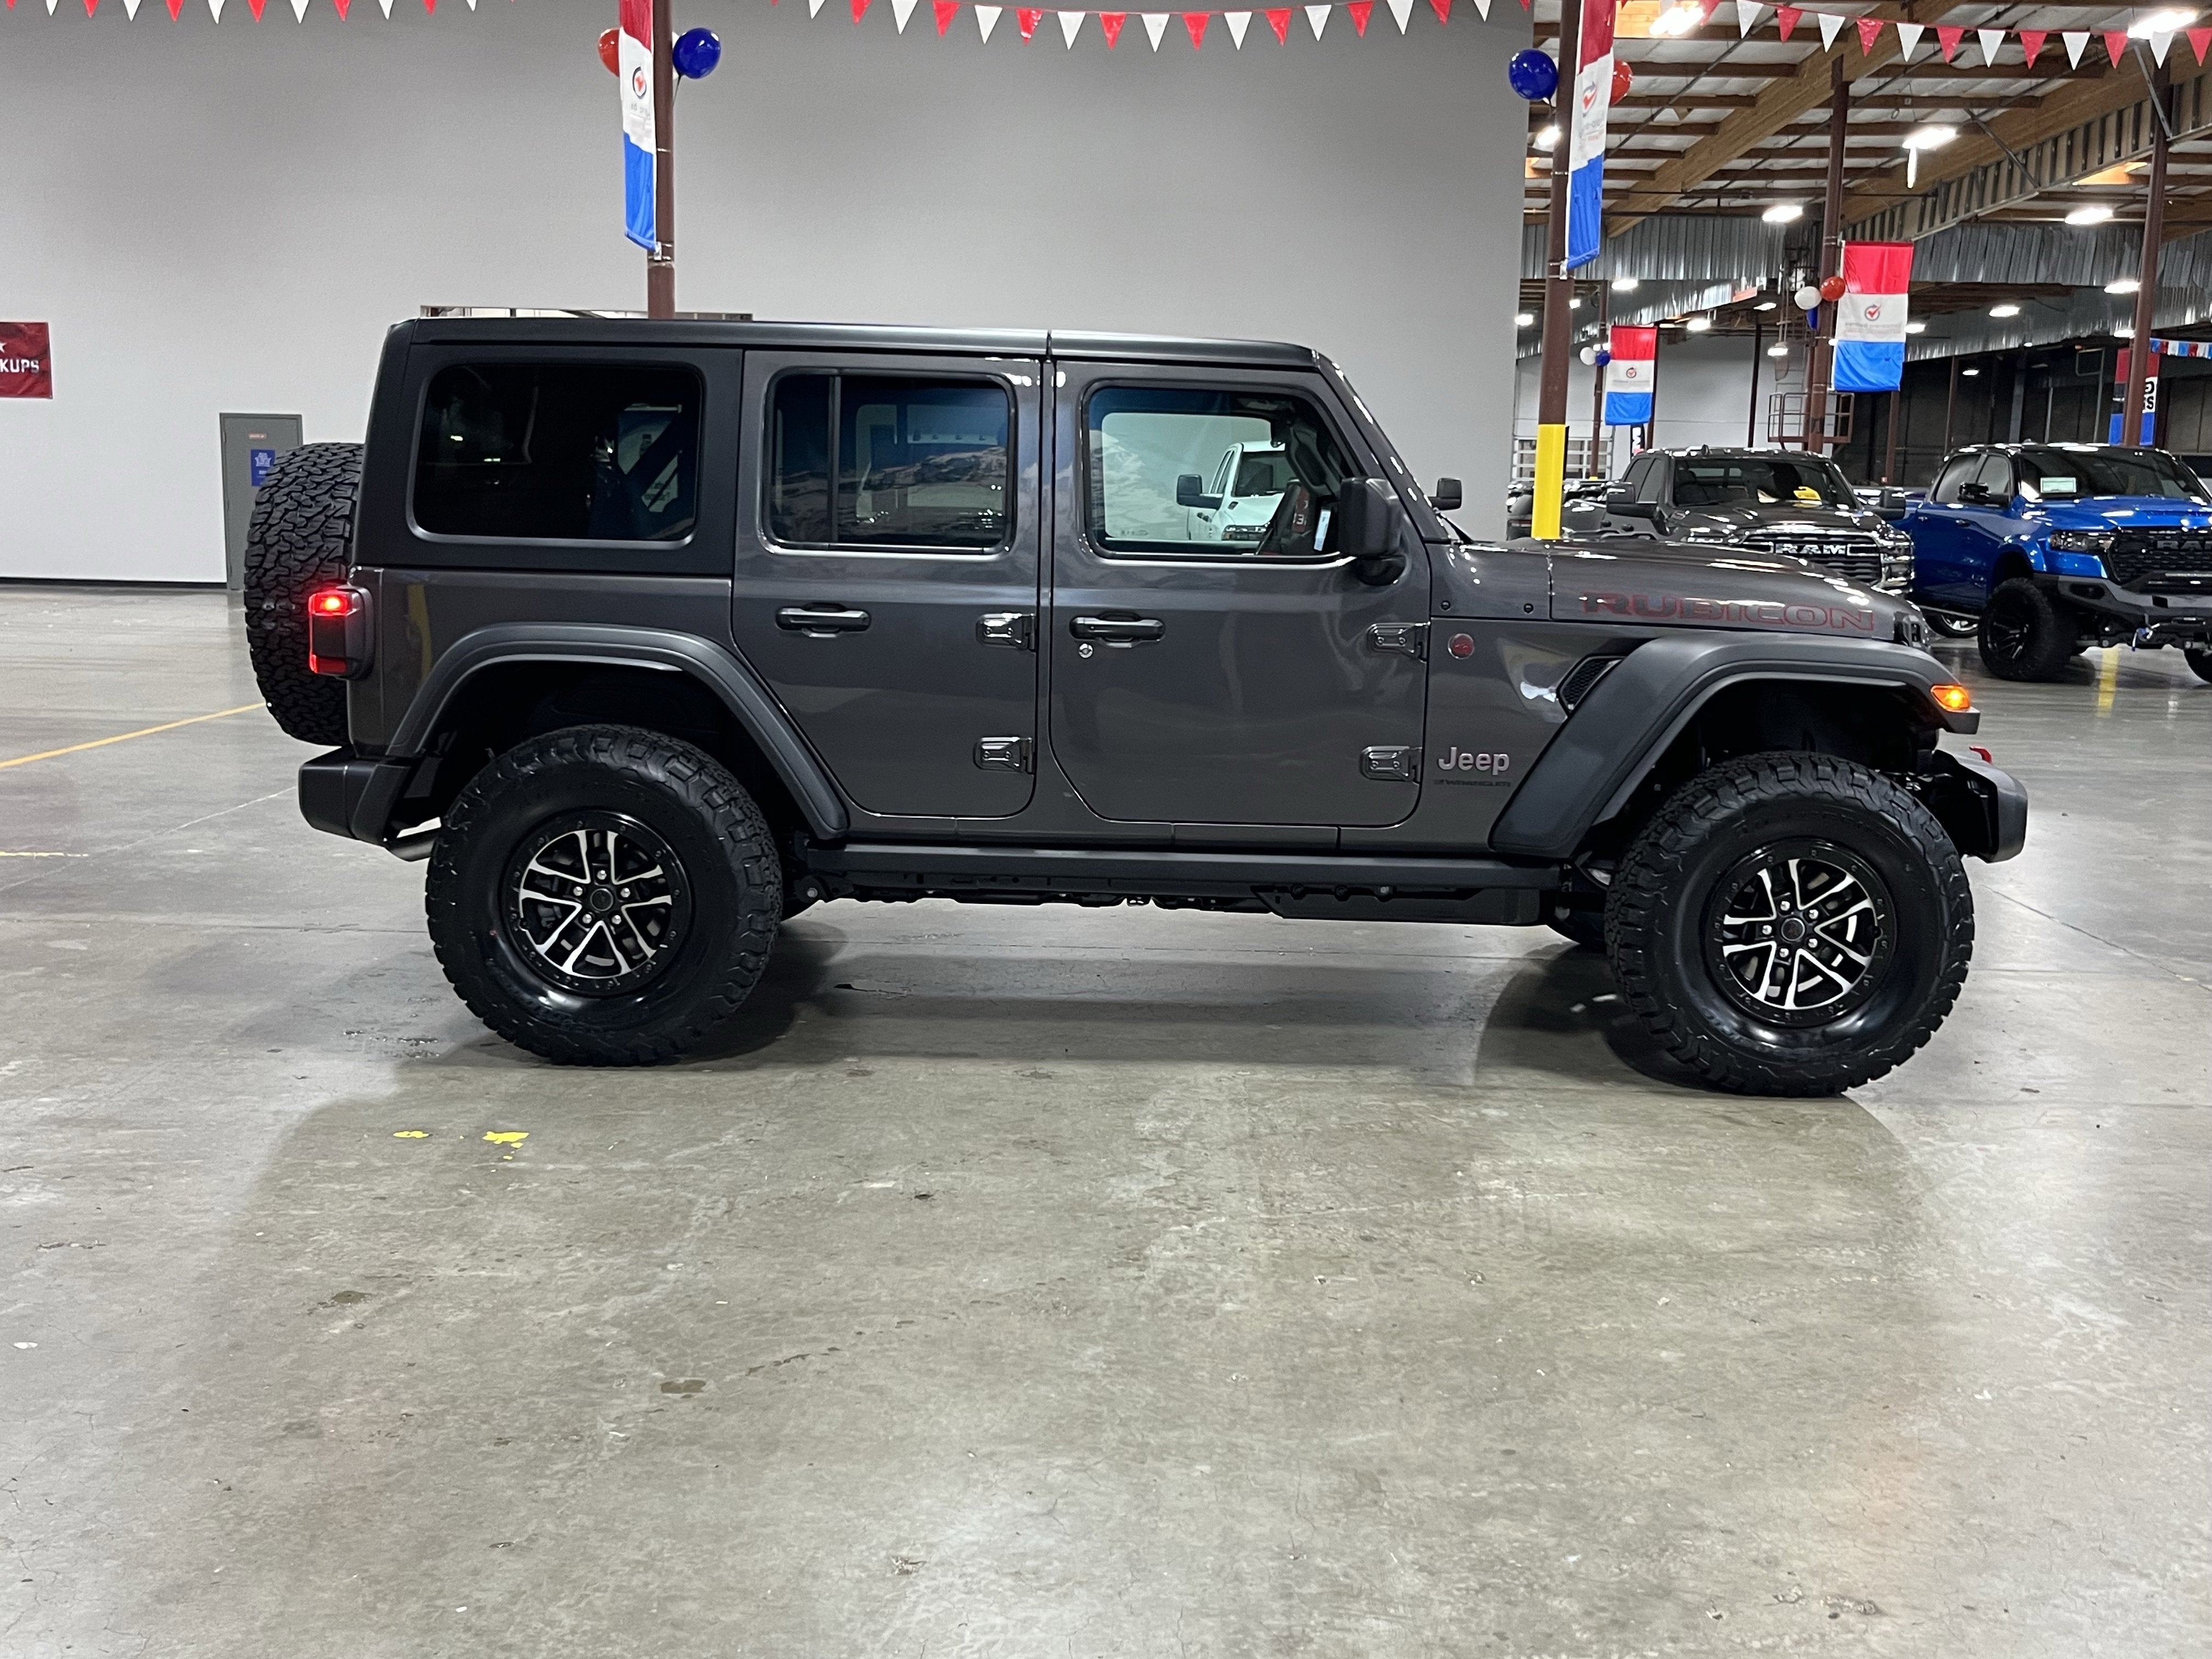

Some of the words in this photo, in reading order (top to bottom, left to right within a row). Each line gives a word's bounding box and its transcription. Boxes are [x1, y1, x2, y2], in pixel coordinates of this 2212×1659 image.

[1775, 543, 1846, 555] RAM
[1582, 591, 1874, 631] RUBICON
[1438, 746, 1510, 775] Jeep
